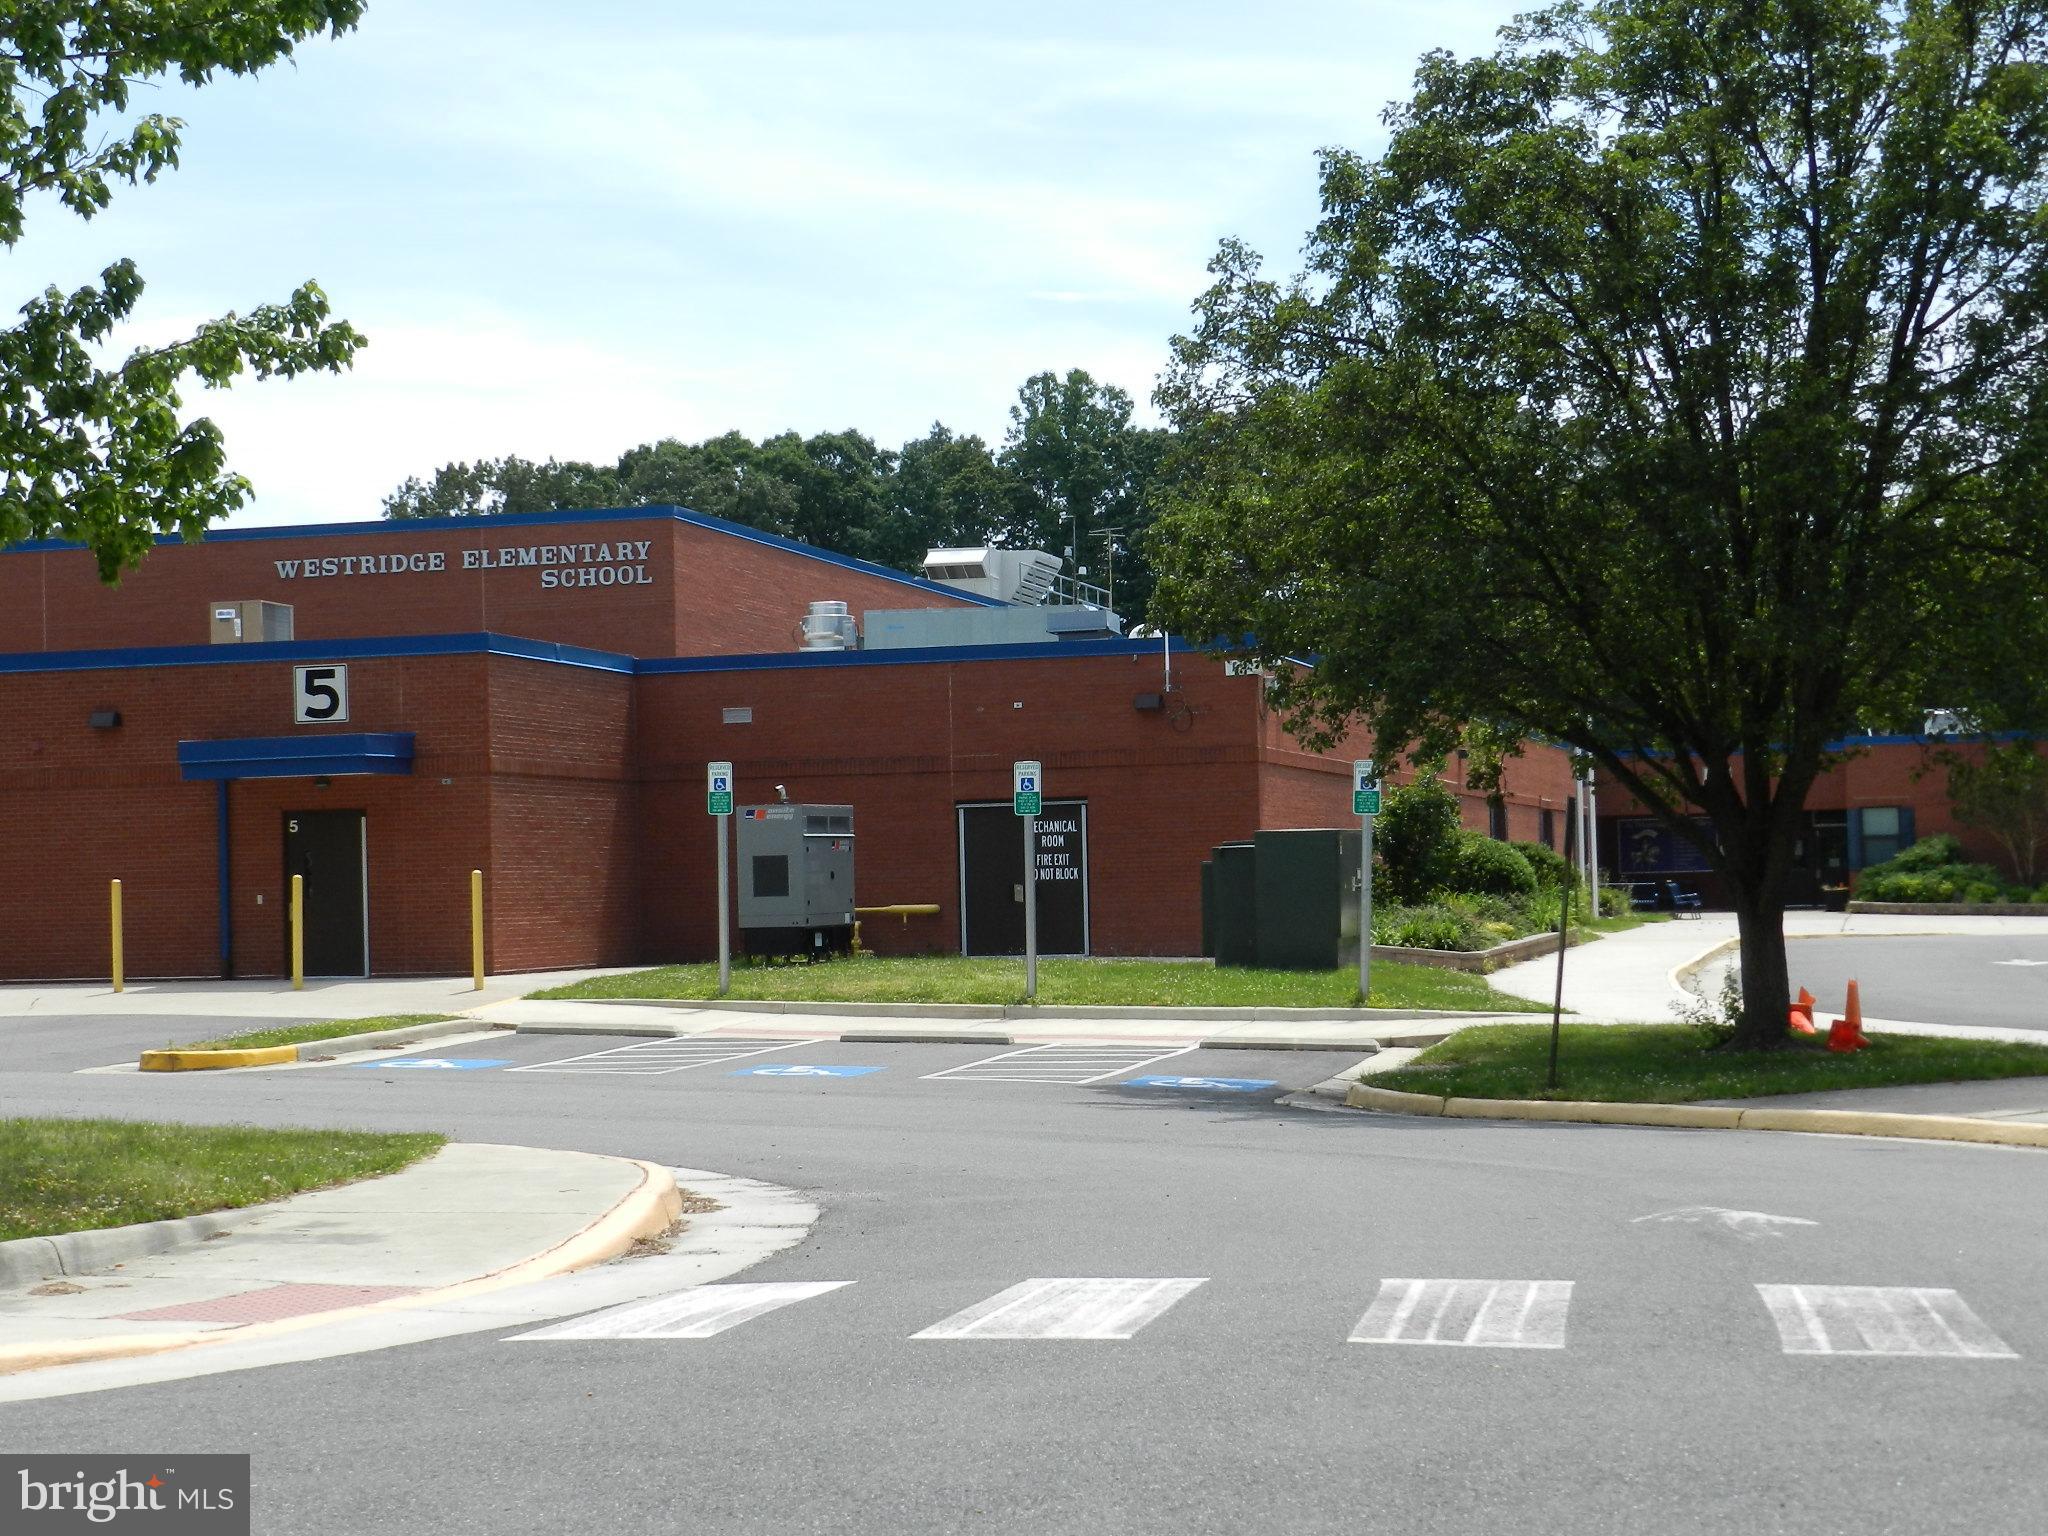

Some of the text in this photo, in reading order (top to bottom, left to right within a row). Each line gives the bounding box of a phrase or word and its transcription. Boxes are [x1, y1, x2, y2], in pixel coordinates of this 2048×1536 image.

[274, 540, 652, 580] WESTRIDGE ELEMENTARY
[540, 565, 653, 589] SCHOOL
[304, 668, 341, 719] 5
[289, 819, 299, 833] 5
[1034, 820, 1077, 833] ECHANICAL
[1041, 835, 1064, 847] ROOM
[1036, 853, 1070, 866] FIRE EXIT
[1040, 867, 1054, 880] NOT
[1056, 867, 1079, 880] BLOCK
